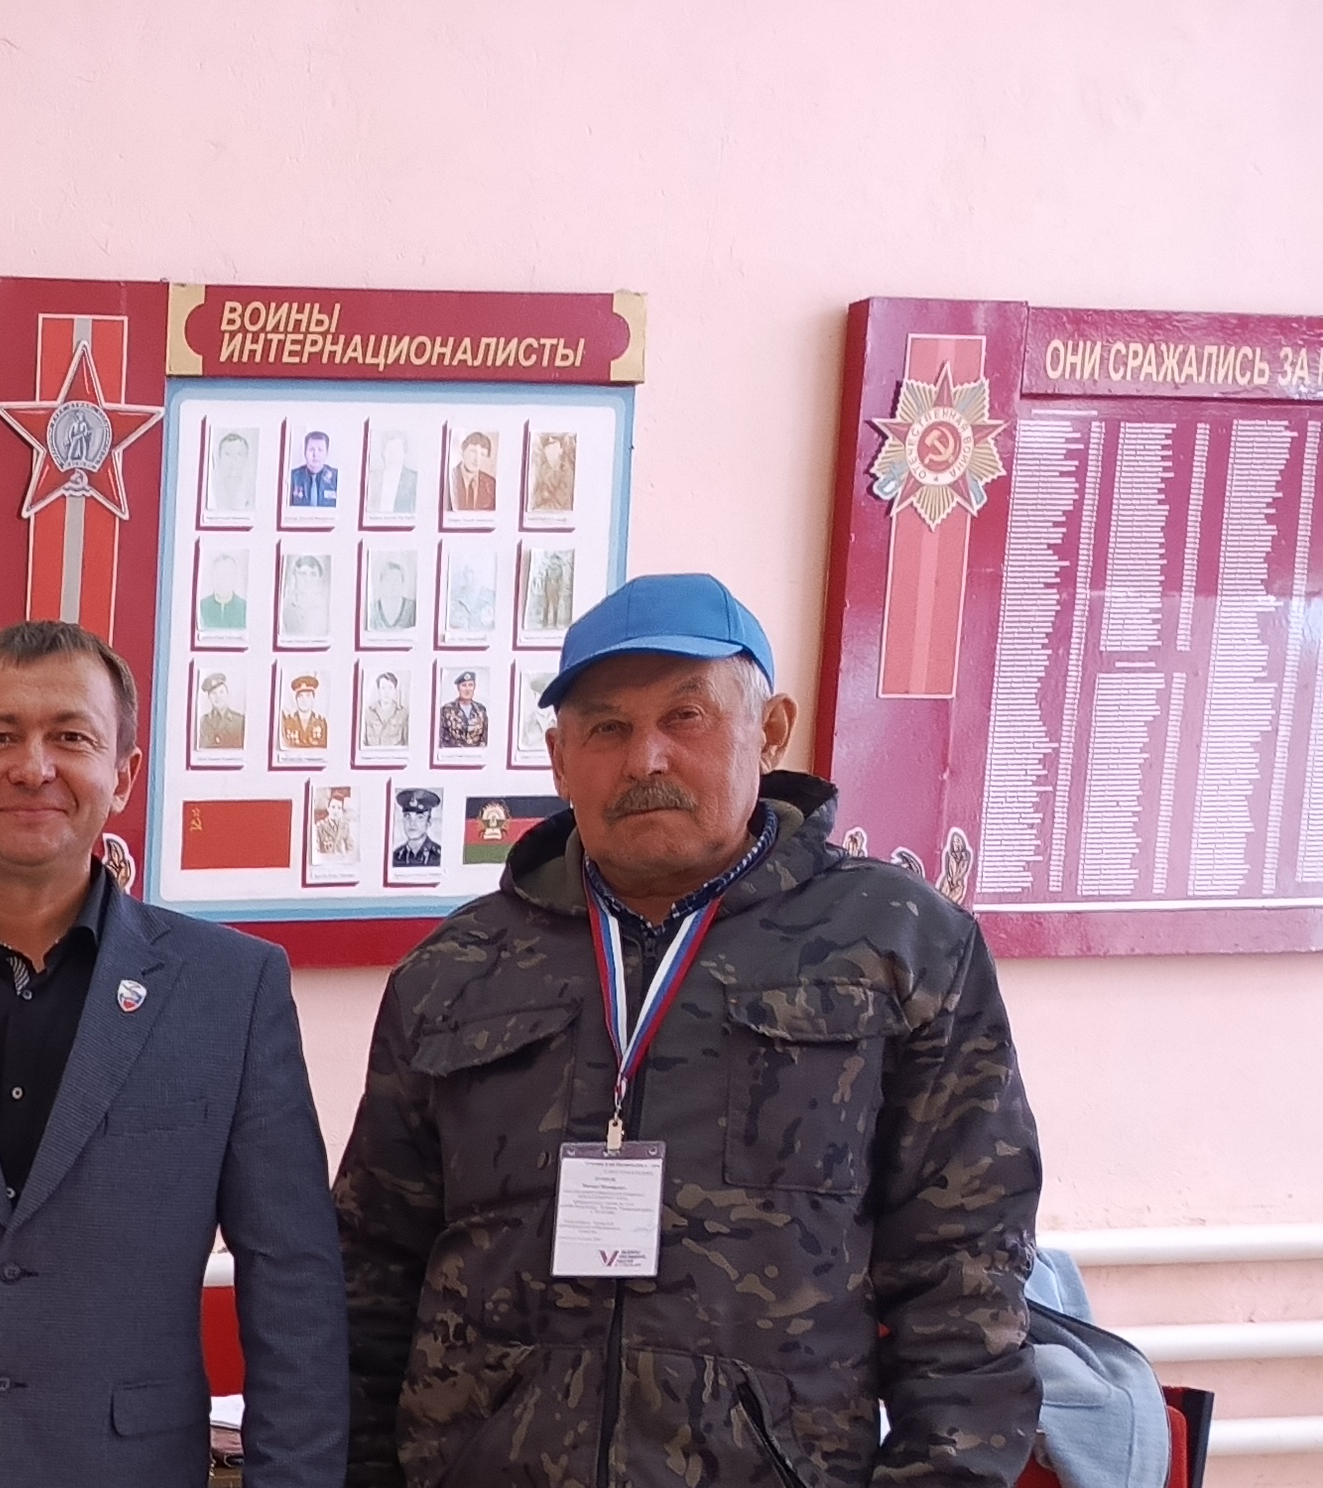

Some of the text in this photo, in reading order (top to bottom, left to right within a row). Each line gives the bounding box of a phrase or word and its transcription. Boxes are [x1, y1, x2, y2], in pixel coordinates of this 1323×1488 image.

[220, 301, 341, 332] ВОИНЫ
[218, 332, 586, 372] ИНТЕРНАЦИОНАЛИСТЫ
[1045, 338, 1102, 381] ОНИ
[1108, 341, 1270, 386] СРАЖАЛИСЬ
[1277, 346, 1312, 387] ЗА
